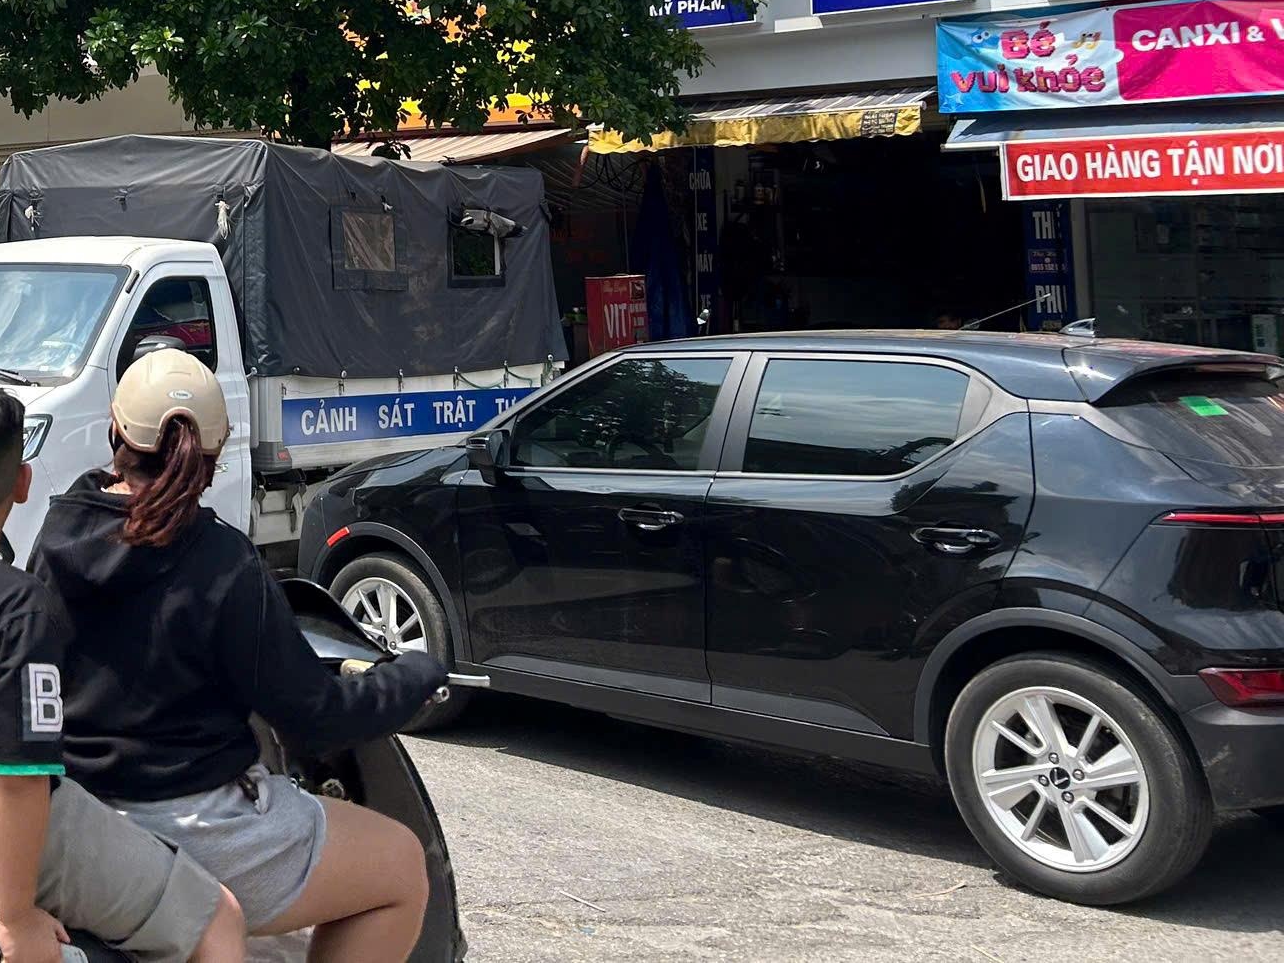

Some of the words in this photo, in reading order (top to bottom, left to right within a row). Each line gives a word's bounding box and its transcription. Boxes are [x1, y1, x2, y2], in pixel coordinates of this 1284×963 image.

[999, 21, 1056, 60] Bé
[1131, 21, 1239, 52] CANXI
[1246, 25, 1265, 43] &
[950, 63, 1011, 94] vui
[1017, 152, 1078, 182] GIAO
[1086, 144, 1161, 180] HÀNG
[1167, 140, 1224, 185] TẬN
[1233, 144, 1284, 175] NƠI
[696, 212, 707, 231] XE
[697, 250, 713, 273] MÁY
[301, 399, 357, 436] CẢNH
[378, 397, 415, 429] SÁT
[433, 394, 476, 428] TRẬT
[28, 663, 63, 732] B
